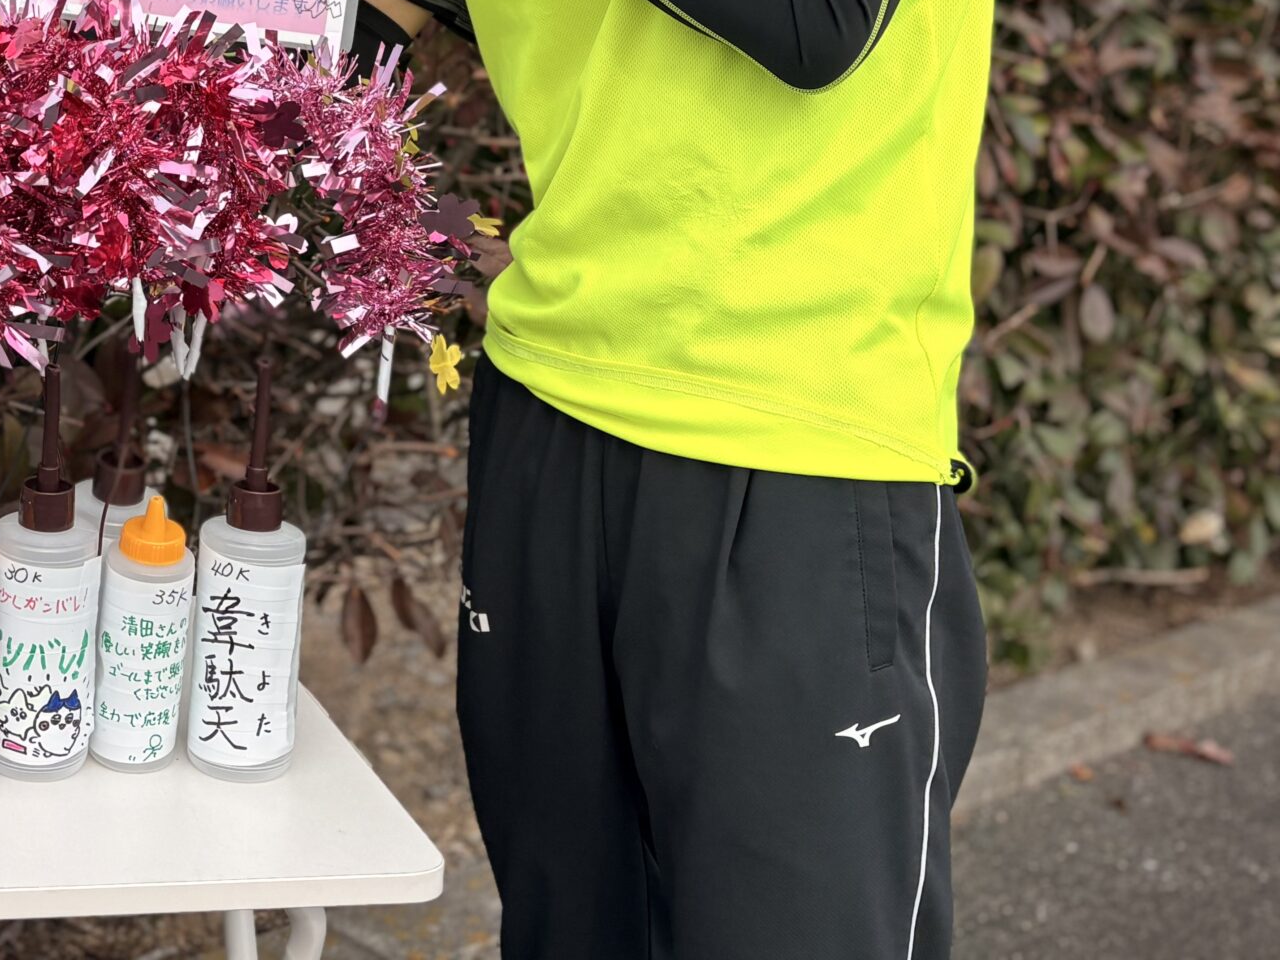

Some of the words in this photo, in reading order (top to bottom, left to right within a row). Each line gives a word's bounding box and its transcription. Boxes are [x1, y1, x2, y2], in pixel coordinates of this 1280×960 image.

[4, 564, 42, 583] 30K
[211, 559, 250, 582] 40K
[152, 589, 188, 607] 35K
[198, 587, 255, 751] 韋駄天
[257, 612, 272, 737] きよた
